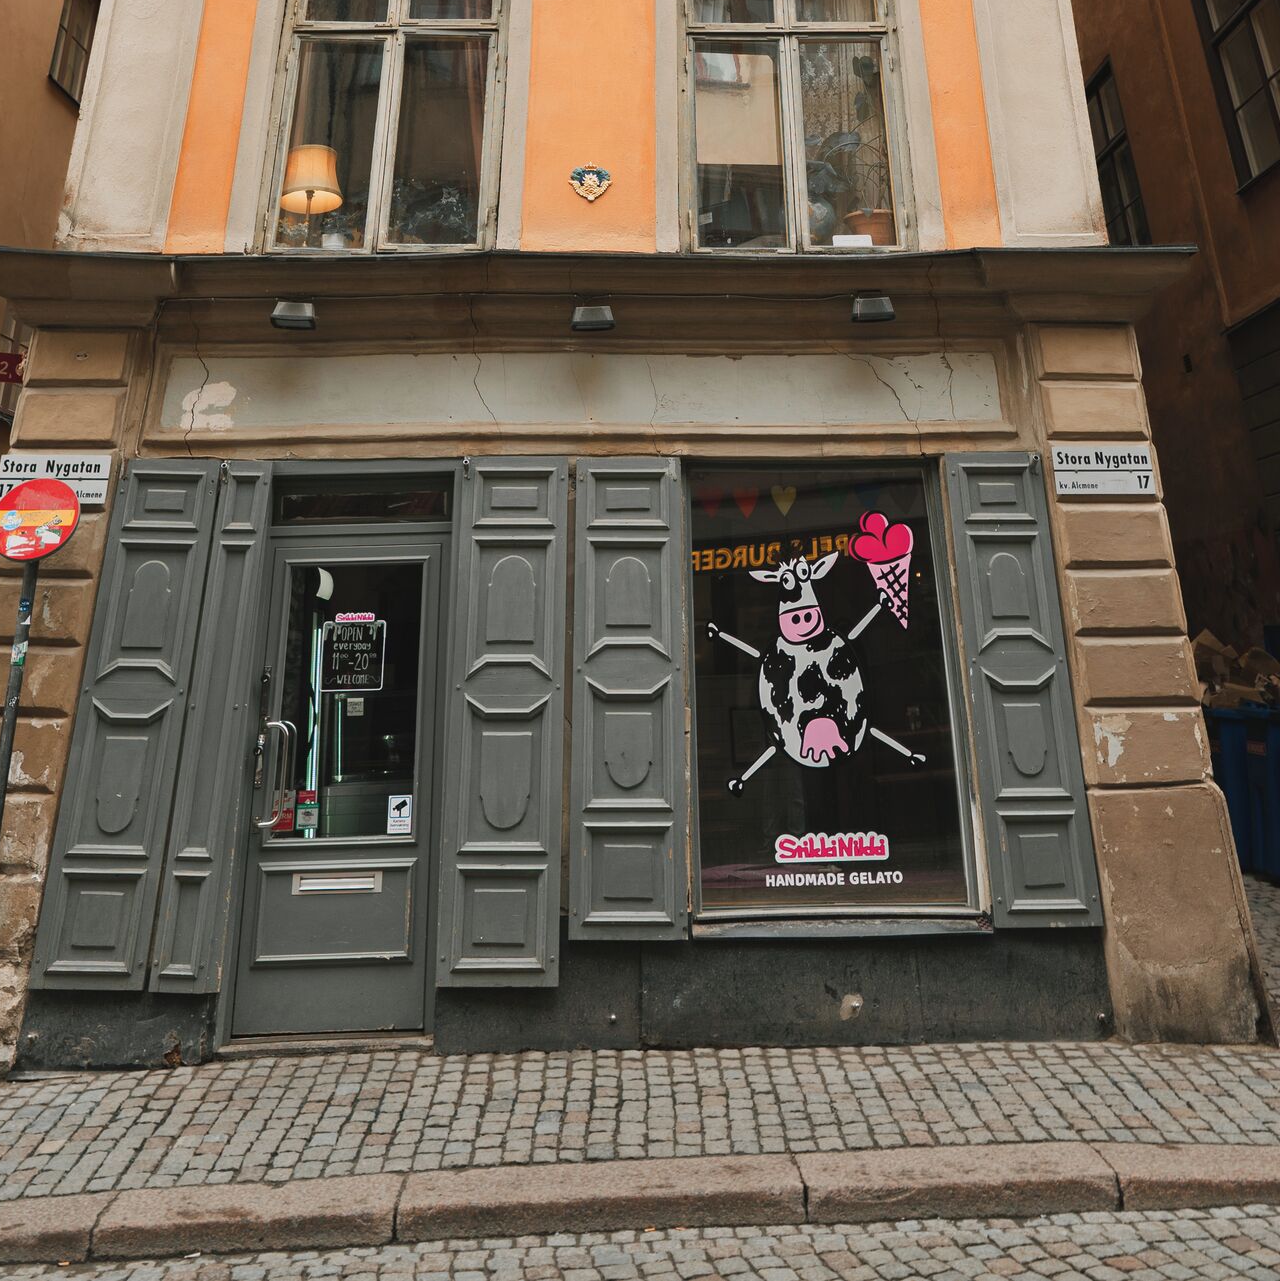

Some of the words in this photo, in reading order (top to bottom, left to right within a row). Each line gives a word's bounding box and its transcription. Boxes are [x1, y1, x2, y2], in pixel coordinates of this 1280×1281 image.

[1056, 451, 1091, 465] Stora
[1094, 451, 1148, 469] Nygatan
[2, 459, 37, 474] Stora
[46, 460, 101, 477] Nygatan
[1059, 481, 1070, 489] kv.
[1072, 481, 1098, 490] Alcmene
[1137, 475, 1150, 489] 17
[341, 626, 363, 641] OPEN
[336, 674, 369, 685] WELCOME
[765, 872, 846, 888] HANDMADE
[849, 871, 904, 886] GELATO
